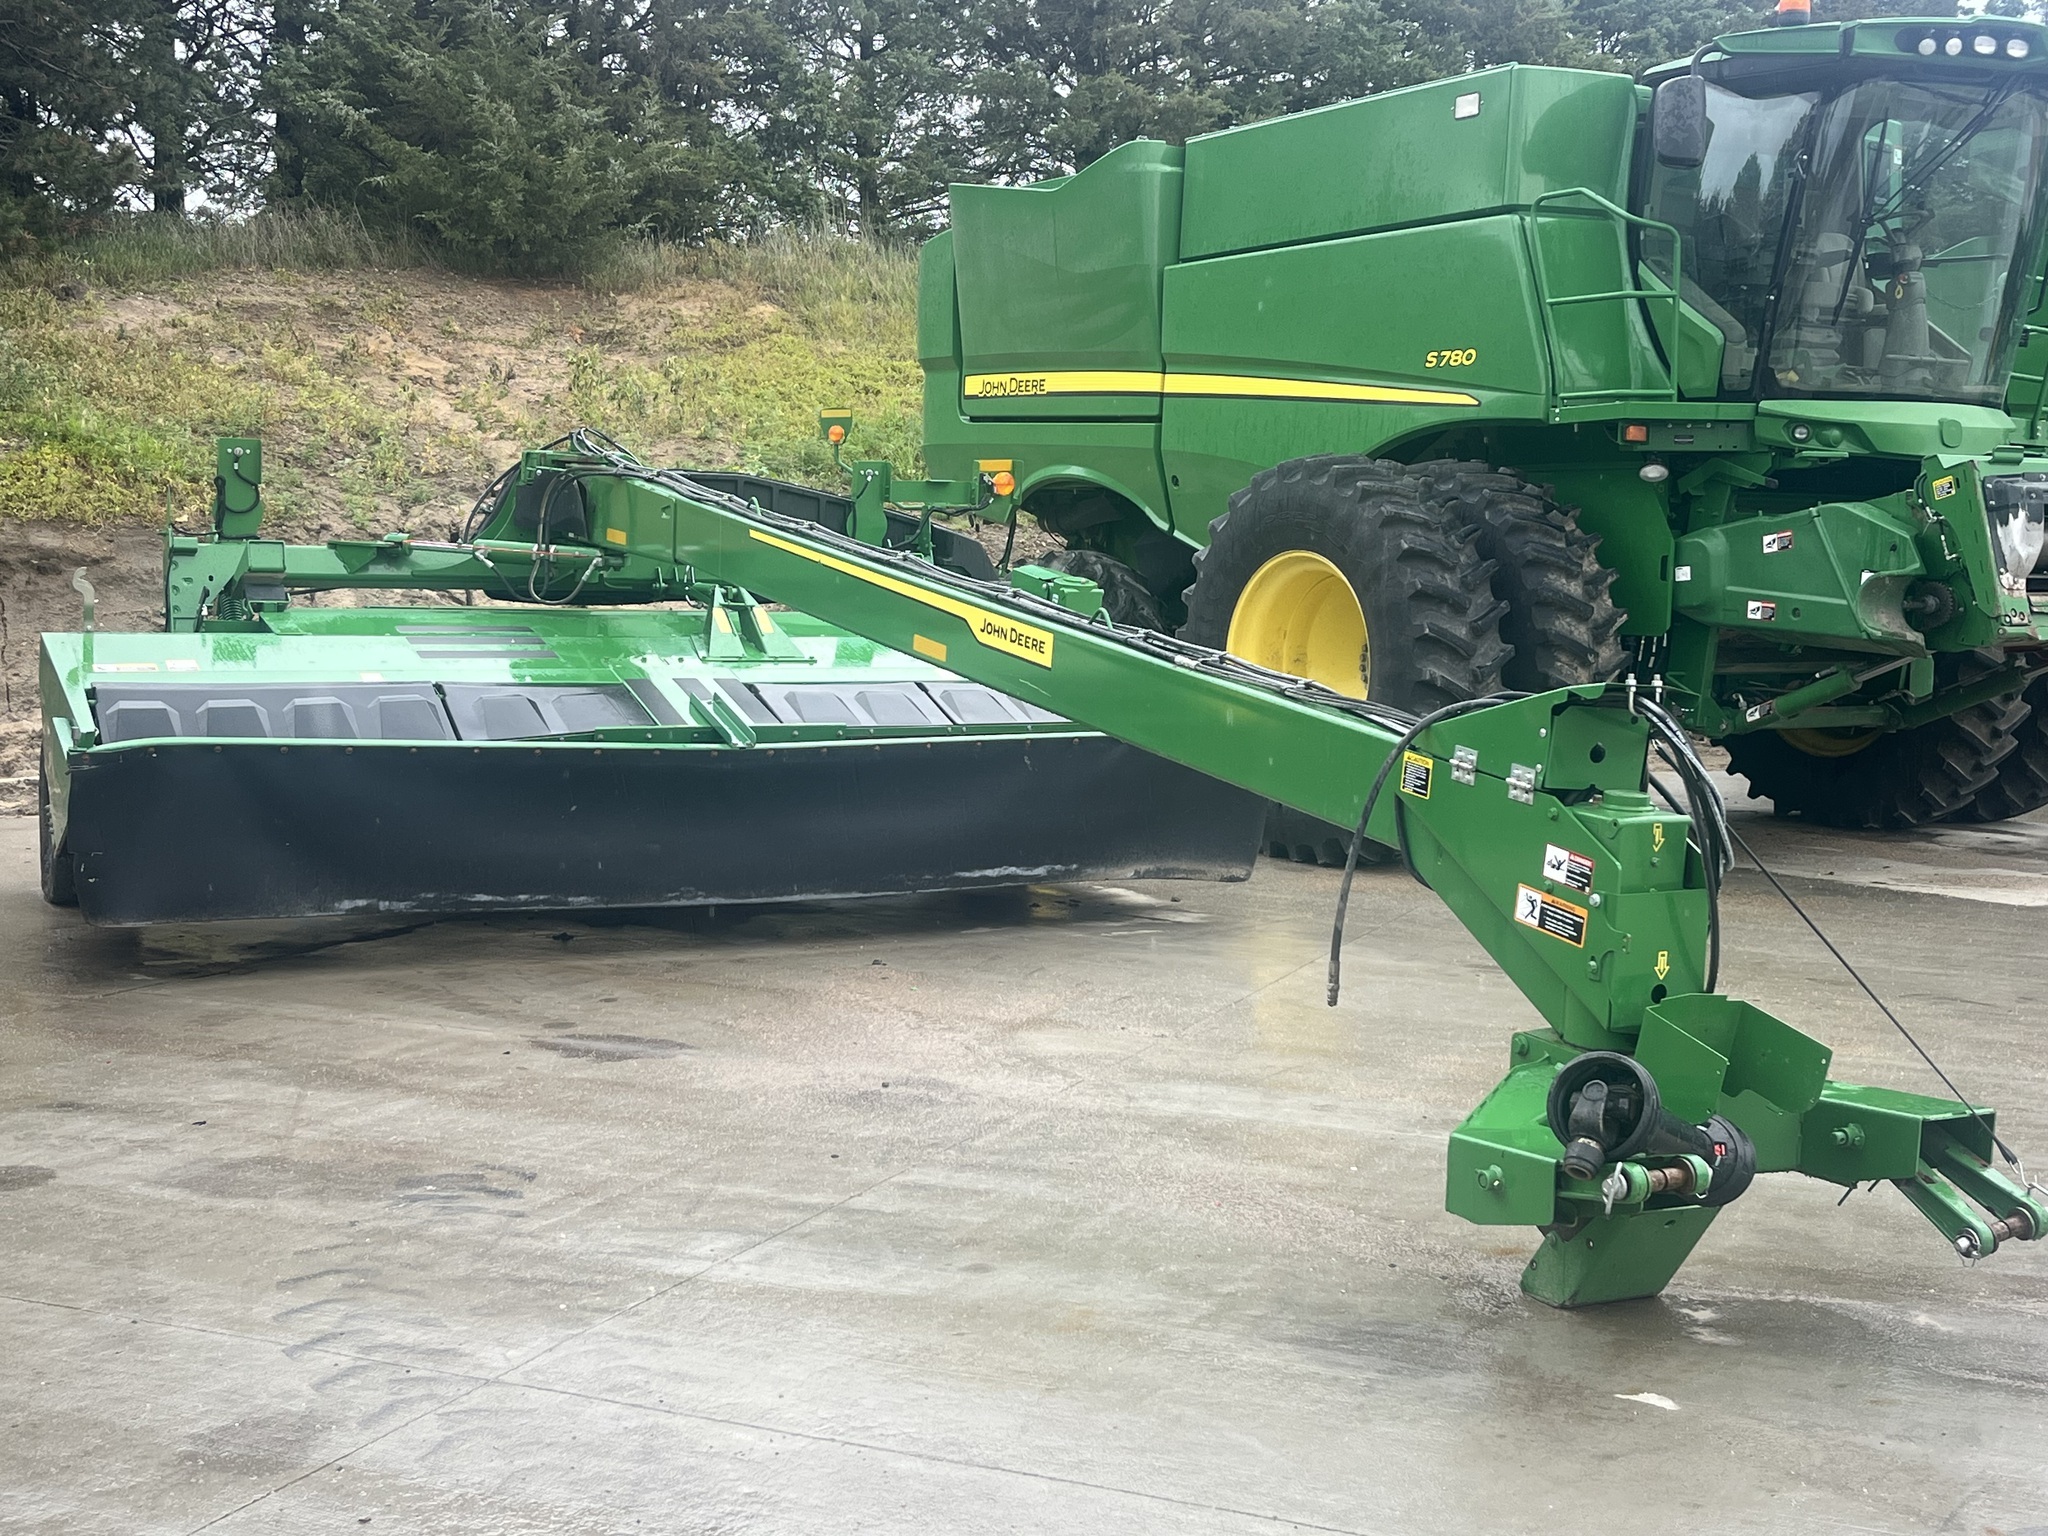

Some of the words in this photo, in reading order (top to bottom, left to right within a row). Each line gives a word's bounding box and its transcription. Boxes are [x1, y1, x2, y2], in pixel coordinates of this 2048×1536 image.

[1424, 348, 1477, 369] S780
[979, 379, 1007, 395] JOHN
[1009, 377, 1046, 393] DEERE
[980, 618, 1008, 641] JOHN
[1009, 627, 1046, 655] DEERE
